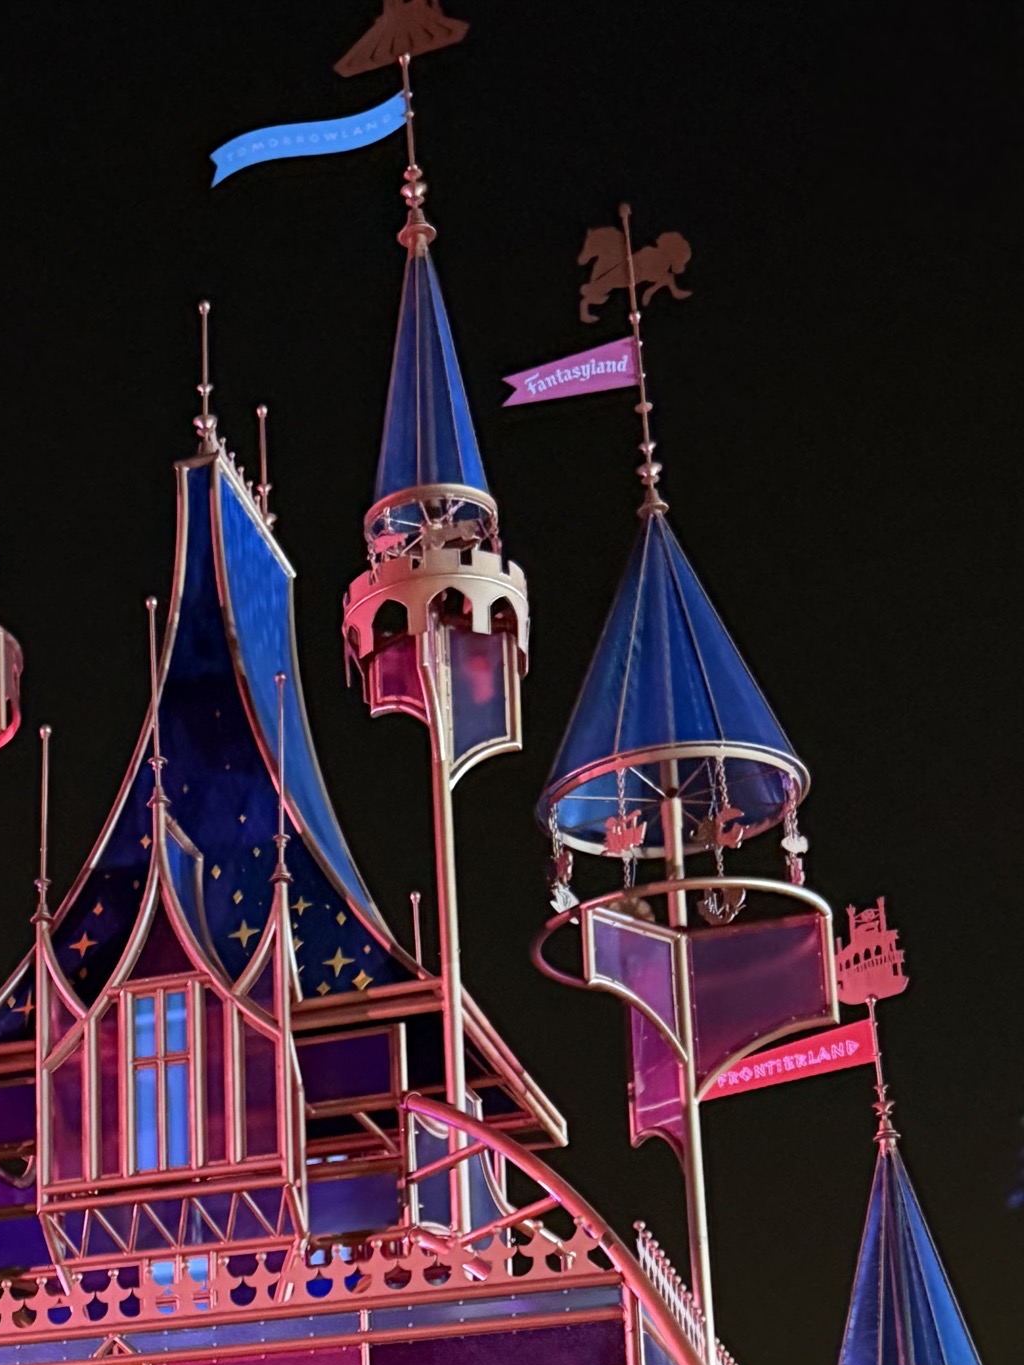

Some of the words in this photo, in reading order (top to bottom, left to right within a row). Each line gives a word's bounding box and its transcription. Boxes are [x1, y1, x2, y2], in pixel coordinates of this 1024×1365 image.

[226, 114, 392, 163] TOMORROWLAND
[524, 355, 628, 396] Fantasyland
[717, 1039, 860, 1088] FRONTIERLAND
